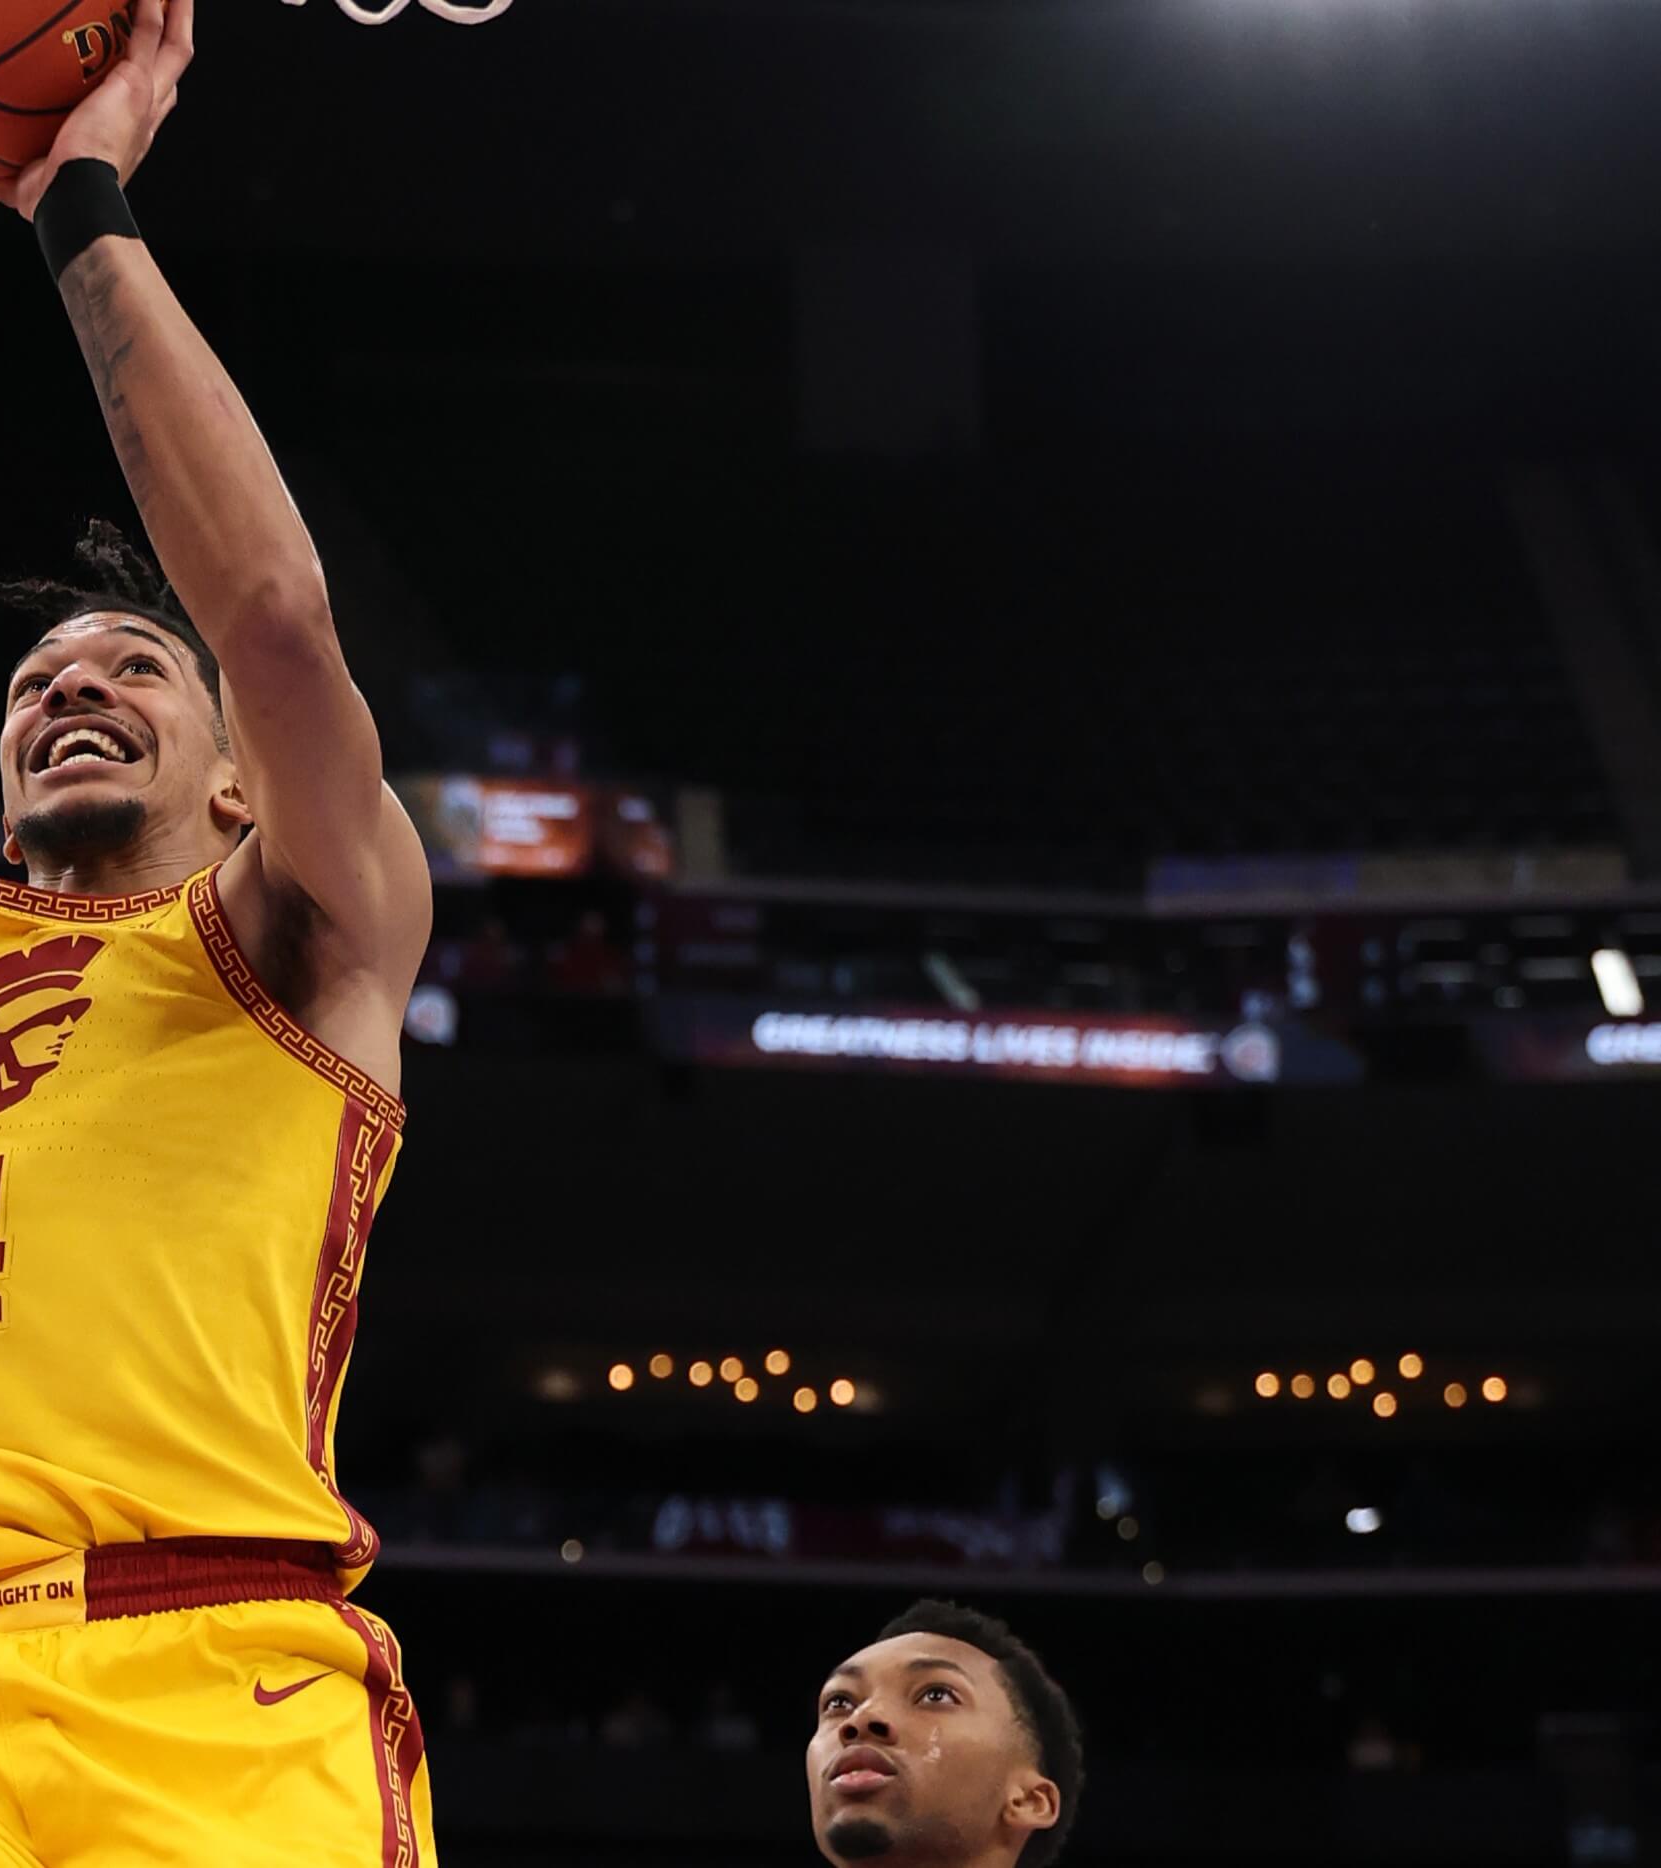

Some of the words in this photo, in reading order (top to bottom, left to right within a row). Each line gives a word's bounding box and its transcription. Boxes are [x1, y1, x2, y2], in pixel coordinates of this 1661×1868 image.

[752, 1011, 972, 1062] GREATNESS
[971, 1022, 1078, 1067] LIVES
[1079, 1028, 1216, 1074] INSIDE
[46, 1580, 74, 1600] ON
